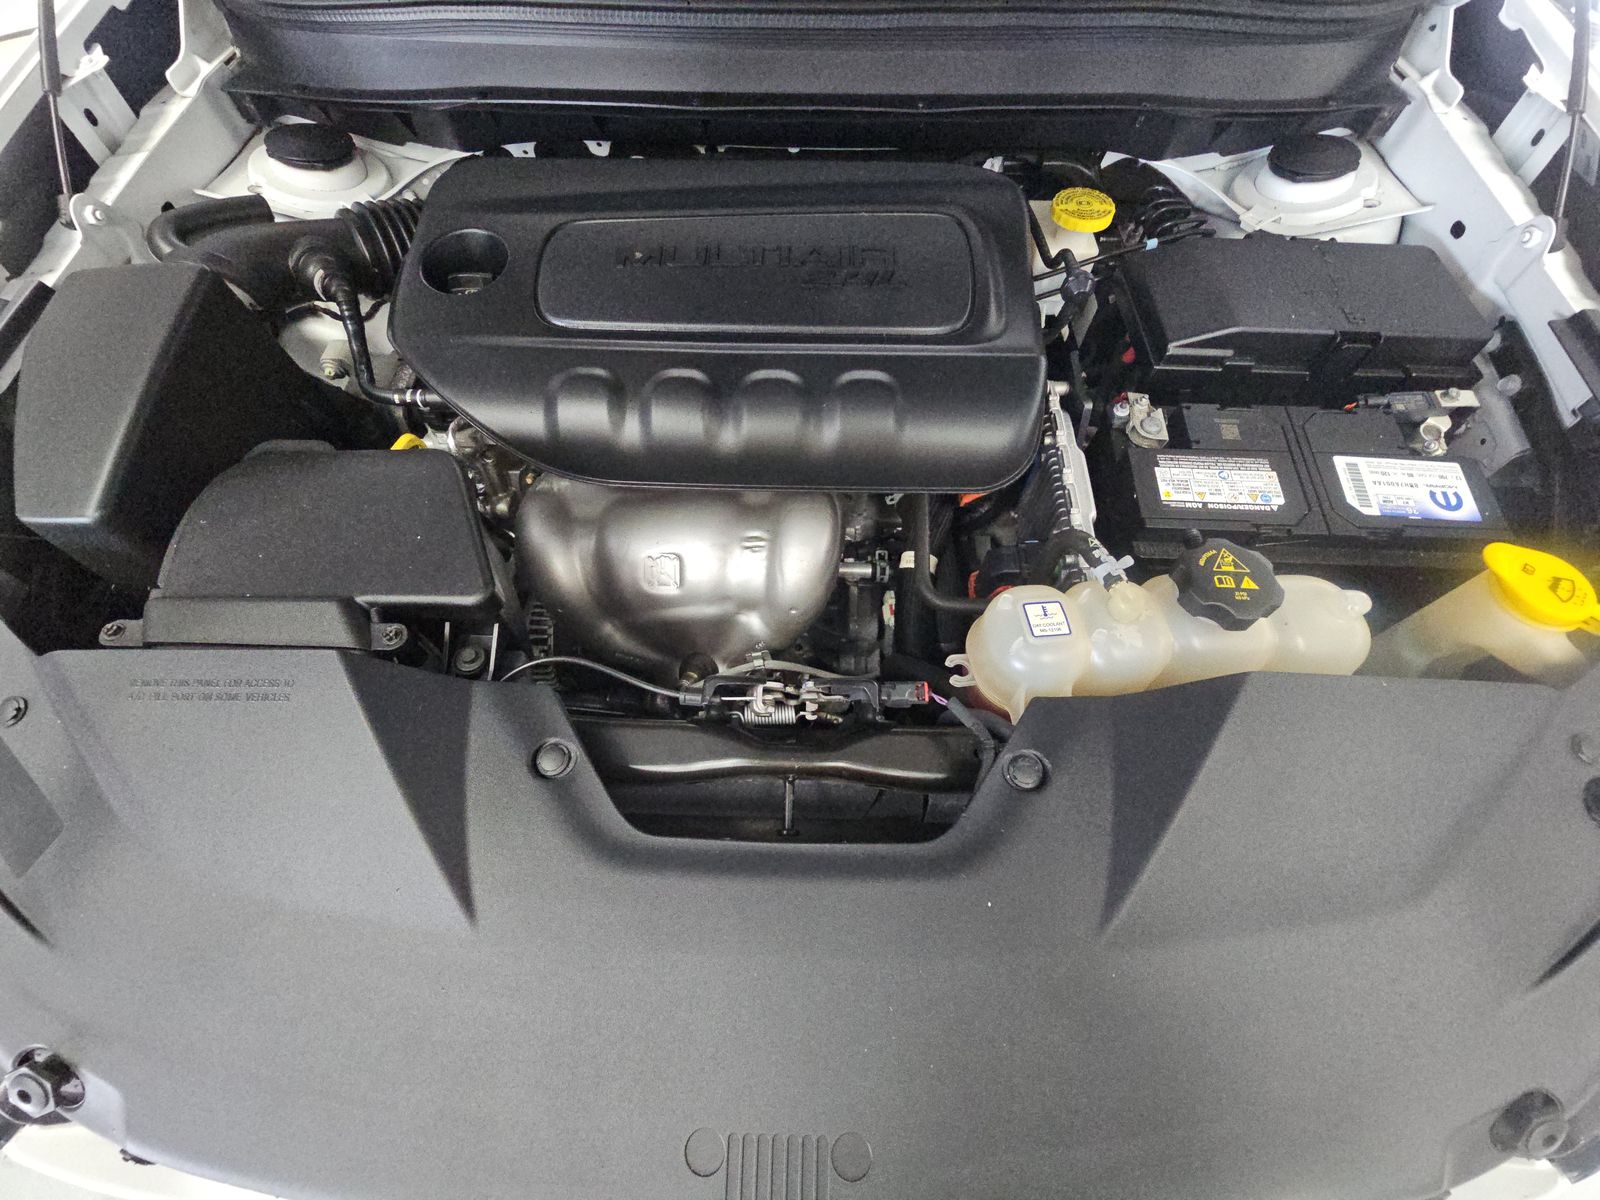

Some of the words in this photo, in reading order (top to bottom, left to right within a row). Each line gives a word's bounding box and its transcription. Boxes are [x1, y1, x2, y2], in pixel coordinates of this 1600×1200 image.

[615, 245, 896, 267] MULTIAIR
[1185, 501, 1203, 509] AGM
[169, 678, 190, 688] THIS
[192, 678, 222, 688] PANEL
[223, 678, 243, 688] FOR
[244, 678, 280, 688] ACCESS
[283, 678, 295, 688] TO
[197, 692, 213, 702] ON
[214, 692, 241, 702] SOME
[246, 692, 291, 702] VEHICLES
